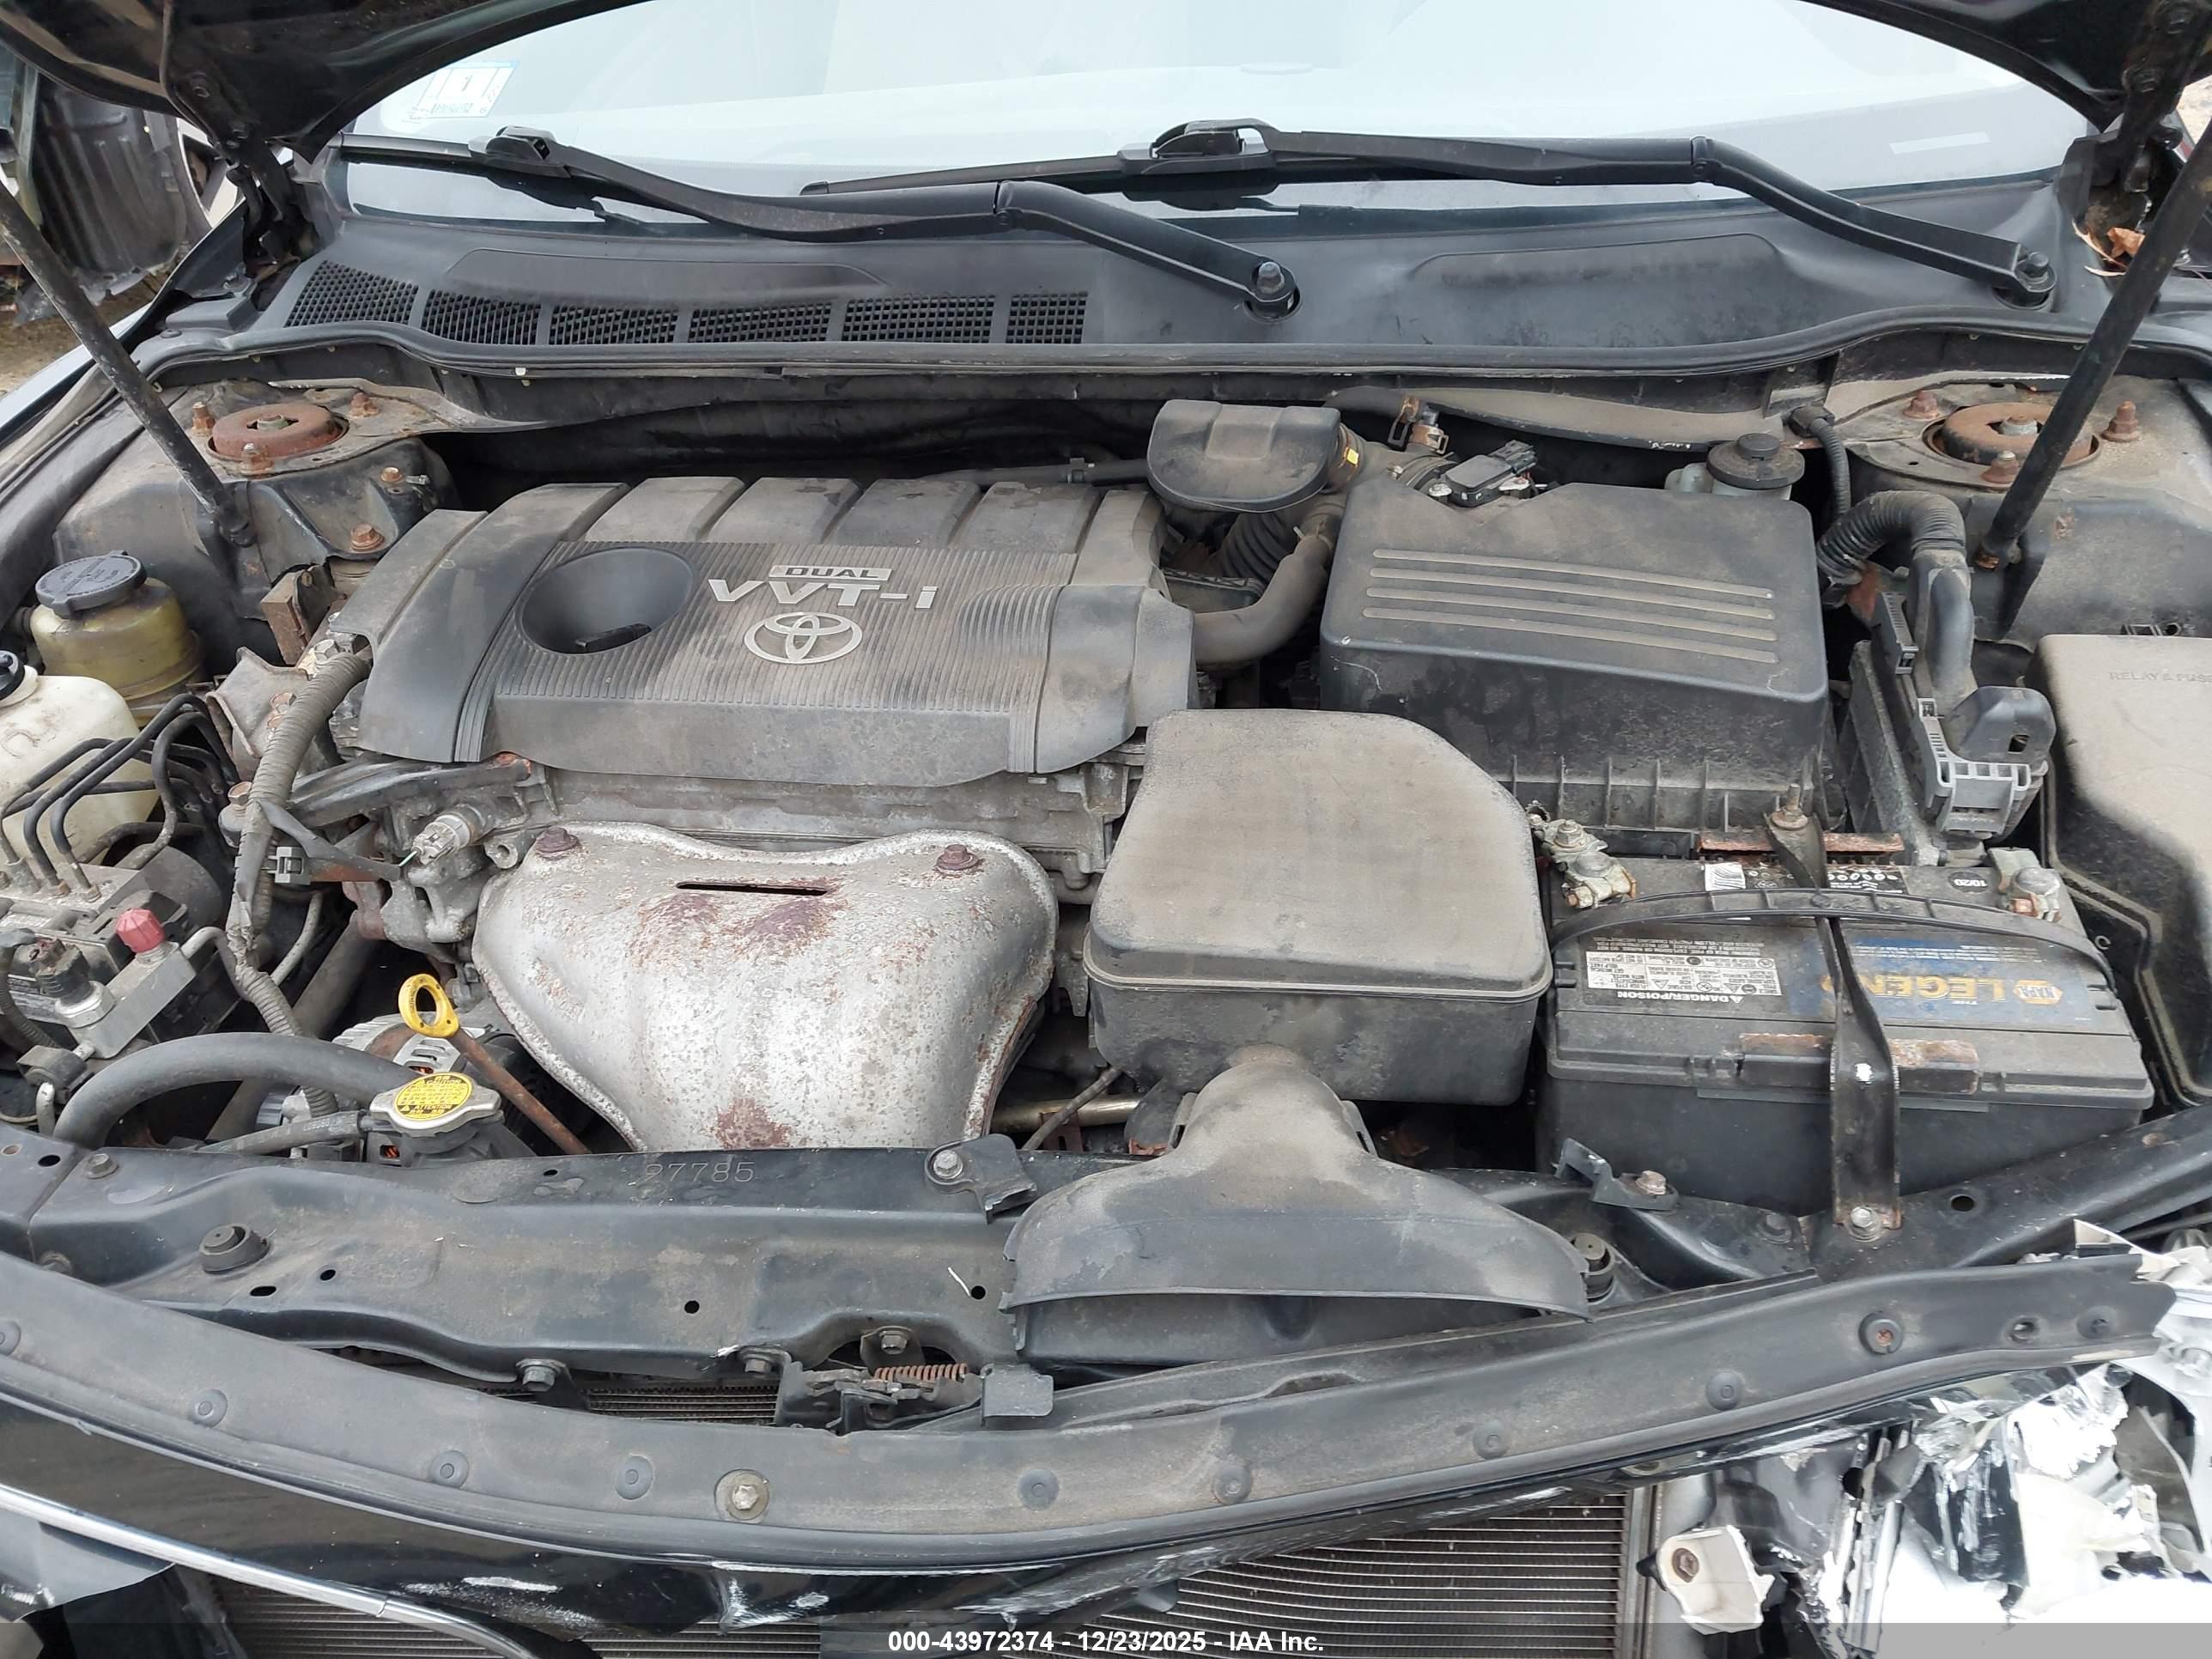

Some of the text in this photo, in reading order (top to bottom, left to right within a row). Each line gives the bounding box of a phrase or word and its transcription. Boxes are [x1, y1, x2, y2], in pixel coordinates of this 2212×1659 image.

[785, 567, 878, 579] DUAL
[708, 579, 939, 609] VVT-i
[2109, 672, 2159, 681] RELAY
[1617, 991, 1729, 1003] DANGER/POISON
[2018, 985, 2055, 998] NAPA
